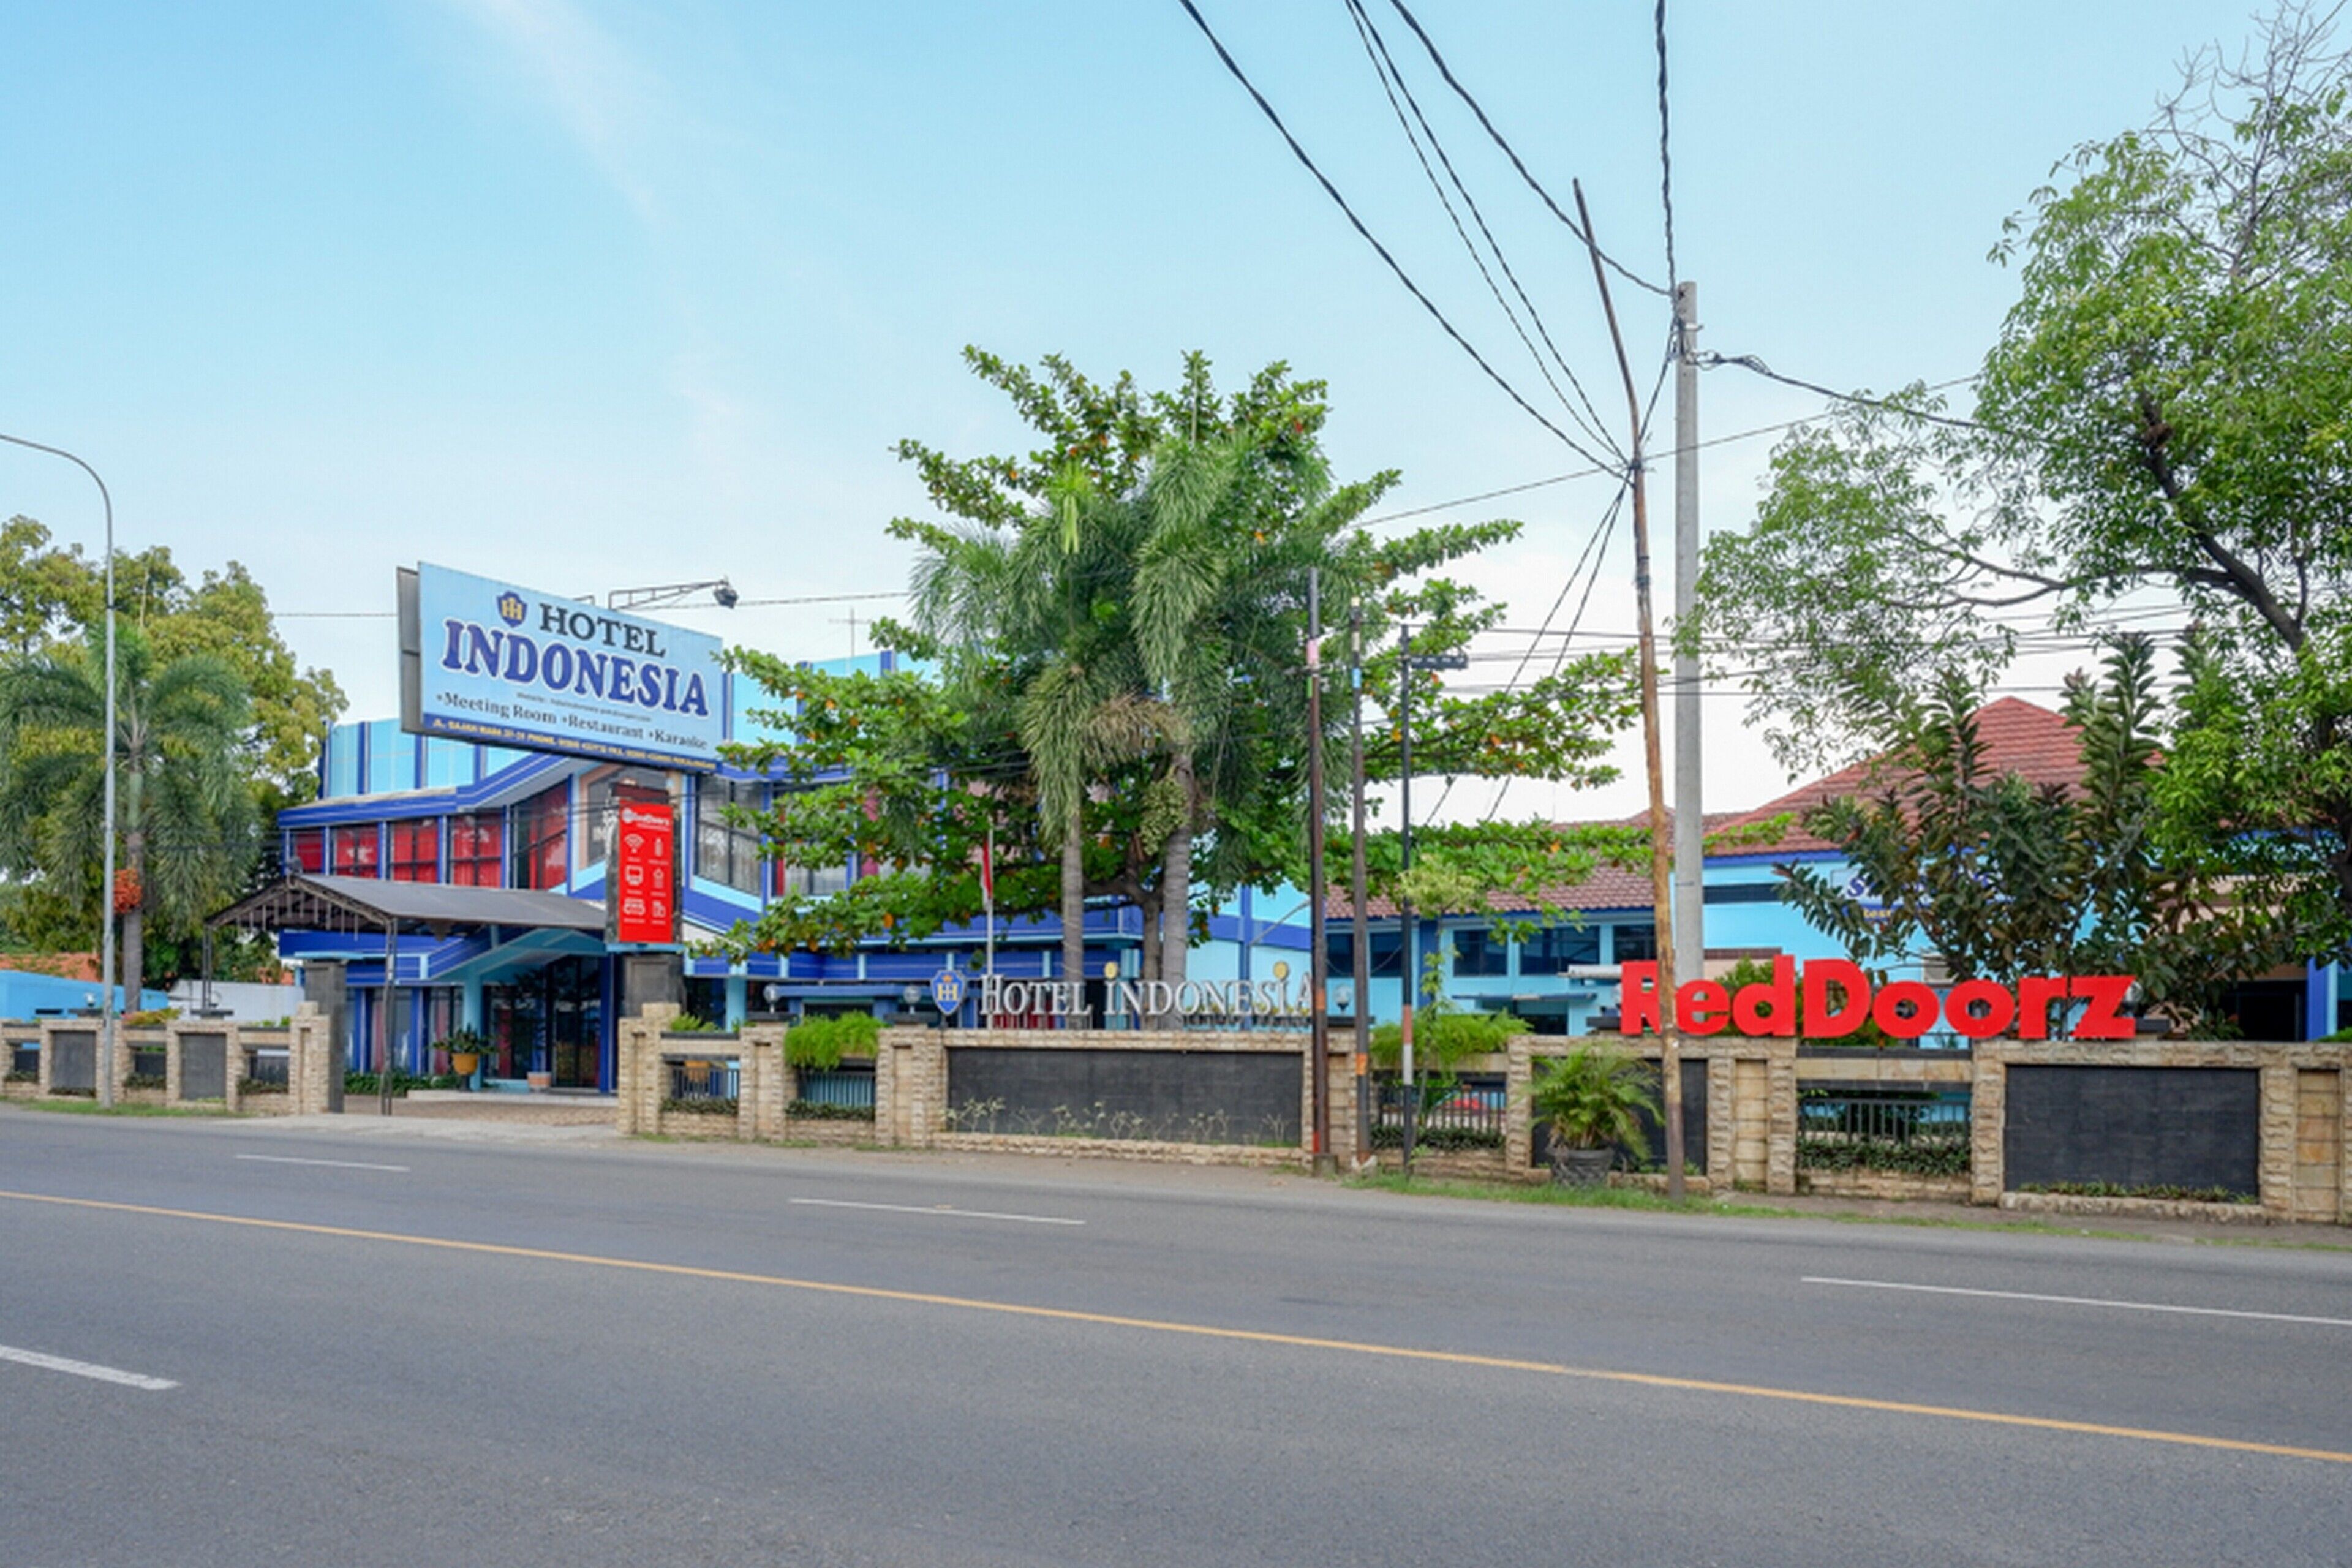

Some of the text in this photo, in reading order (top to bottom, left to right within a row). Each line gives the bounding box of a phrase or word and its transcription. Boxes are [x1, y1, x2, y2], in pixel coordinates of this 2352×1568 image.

[539, 603, 666, 658] HOTEL
[443, 620, 709, 717] INDONESIA
[445, 692, 510, 719] Meeting
[513, 704, 557, 724] Room
[568, 714, 643, 739] Restaurant
[655, 729, 708, 750] Karaoke
[979, 971, 1313, 1017] HOTEL INDONESIA
[1621, 954, 2136, 1040] RedDoorz
